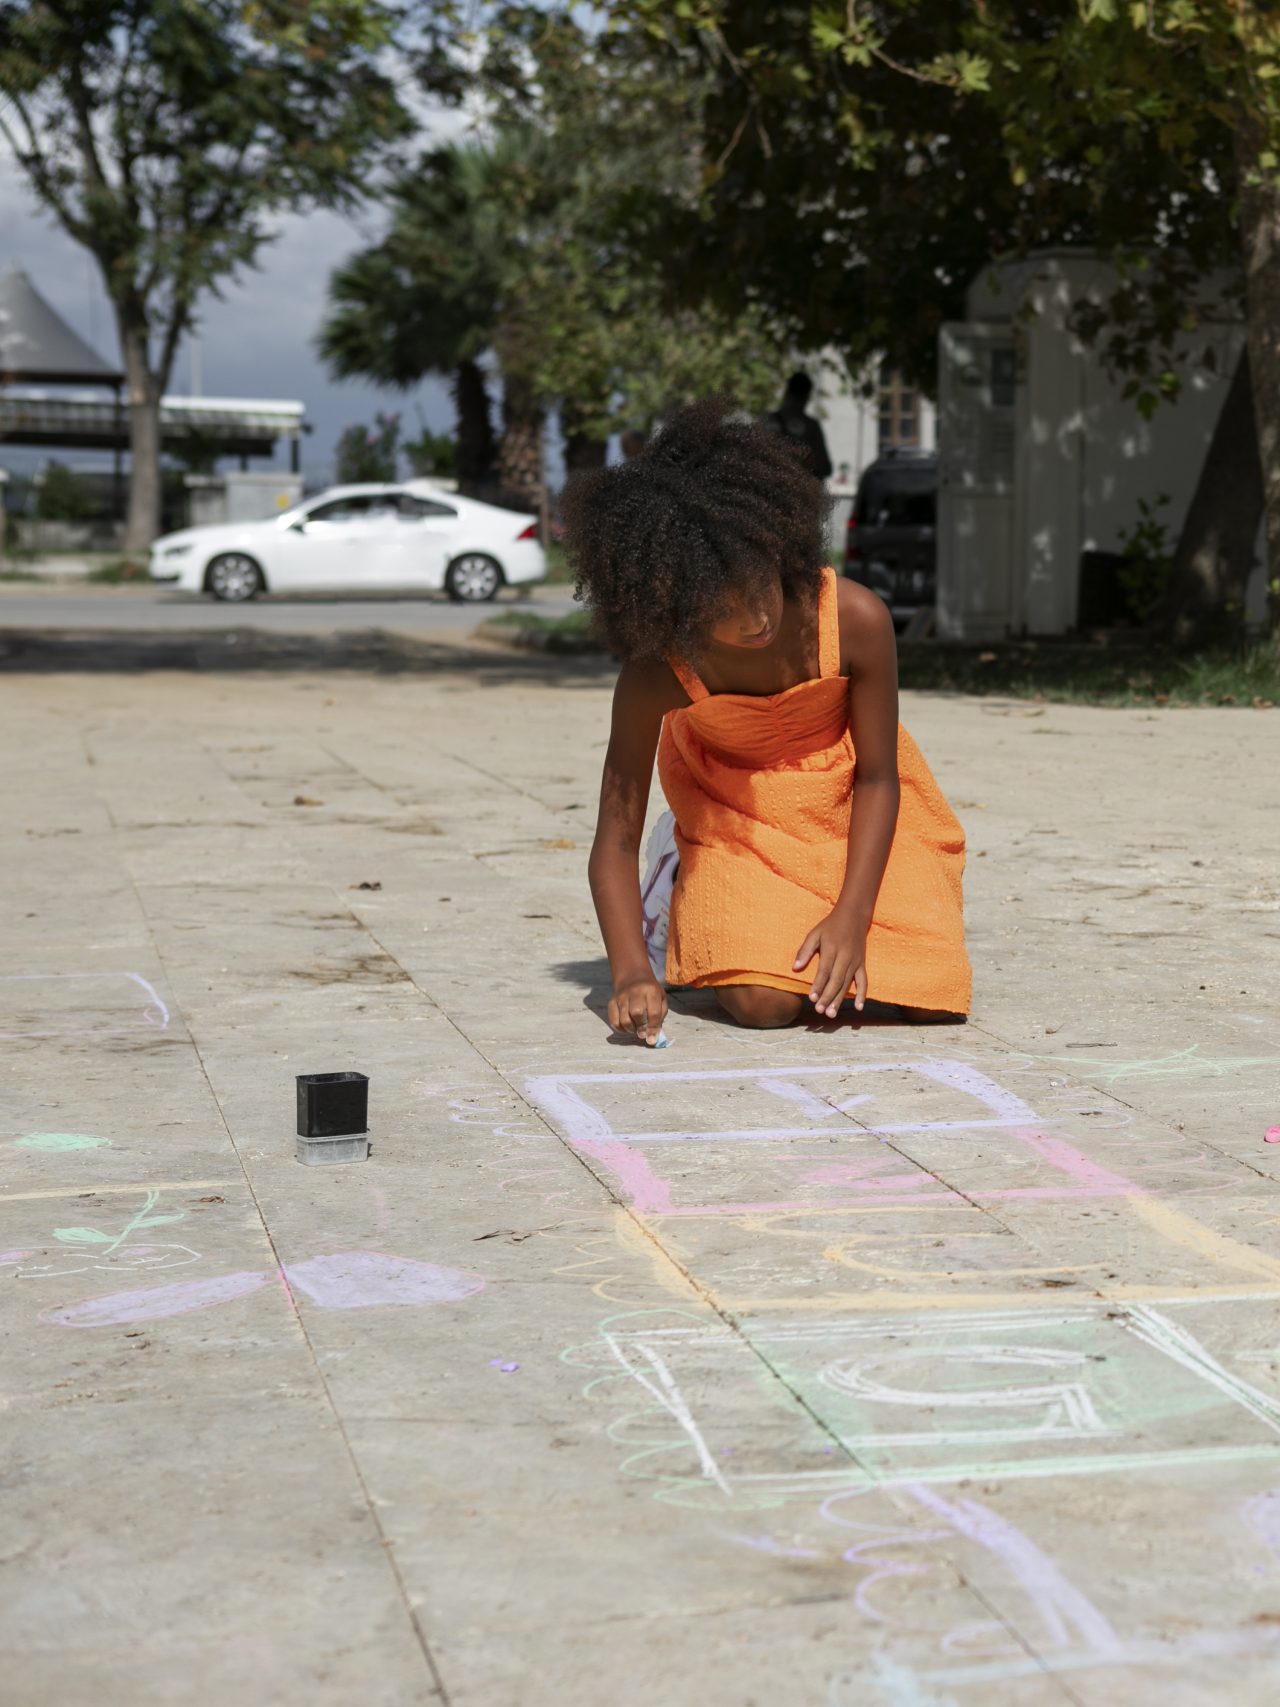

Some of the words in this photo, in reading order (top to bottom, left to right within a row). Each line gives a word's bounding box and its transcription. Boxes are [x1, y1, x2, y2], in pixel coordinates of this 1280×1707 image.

[757, 1077, 875, 1121] 1
[772, 1154, 938, 1188] 2
[733, 1206, 1112, 1279] 3
[816, 1345, 1124, 1449] 5
